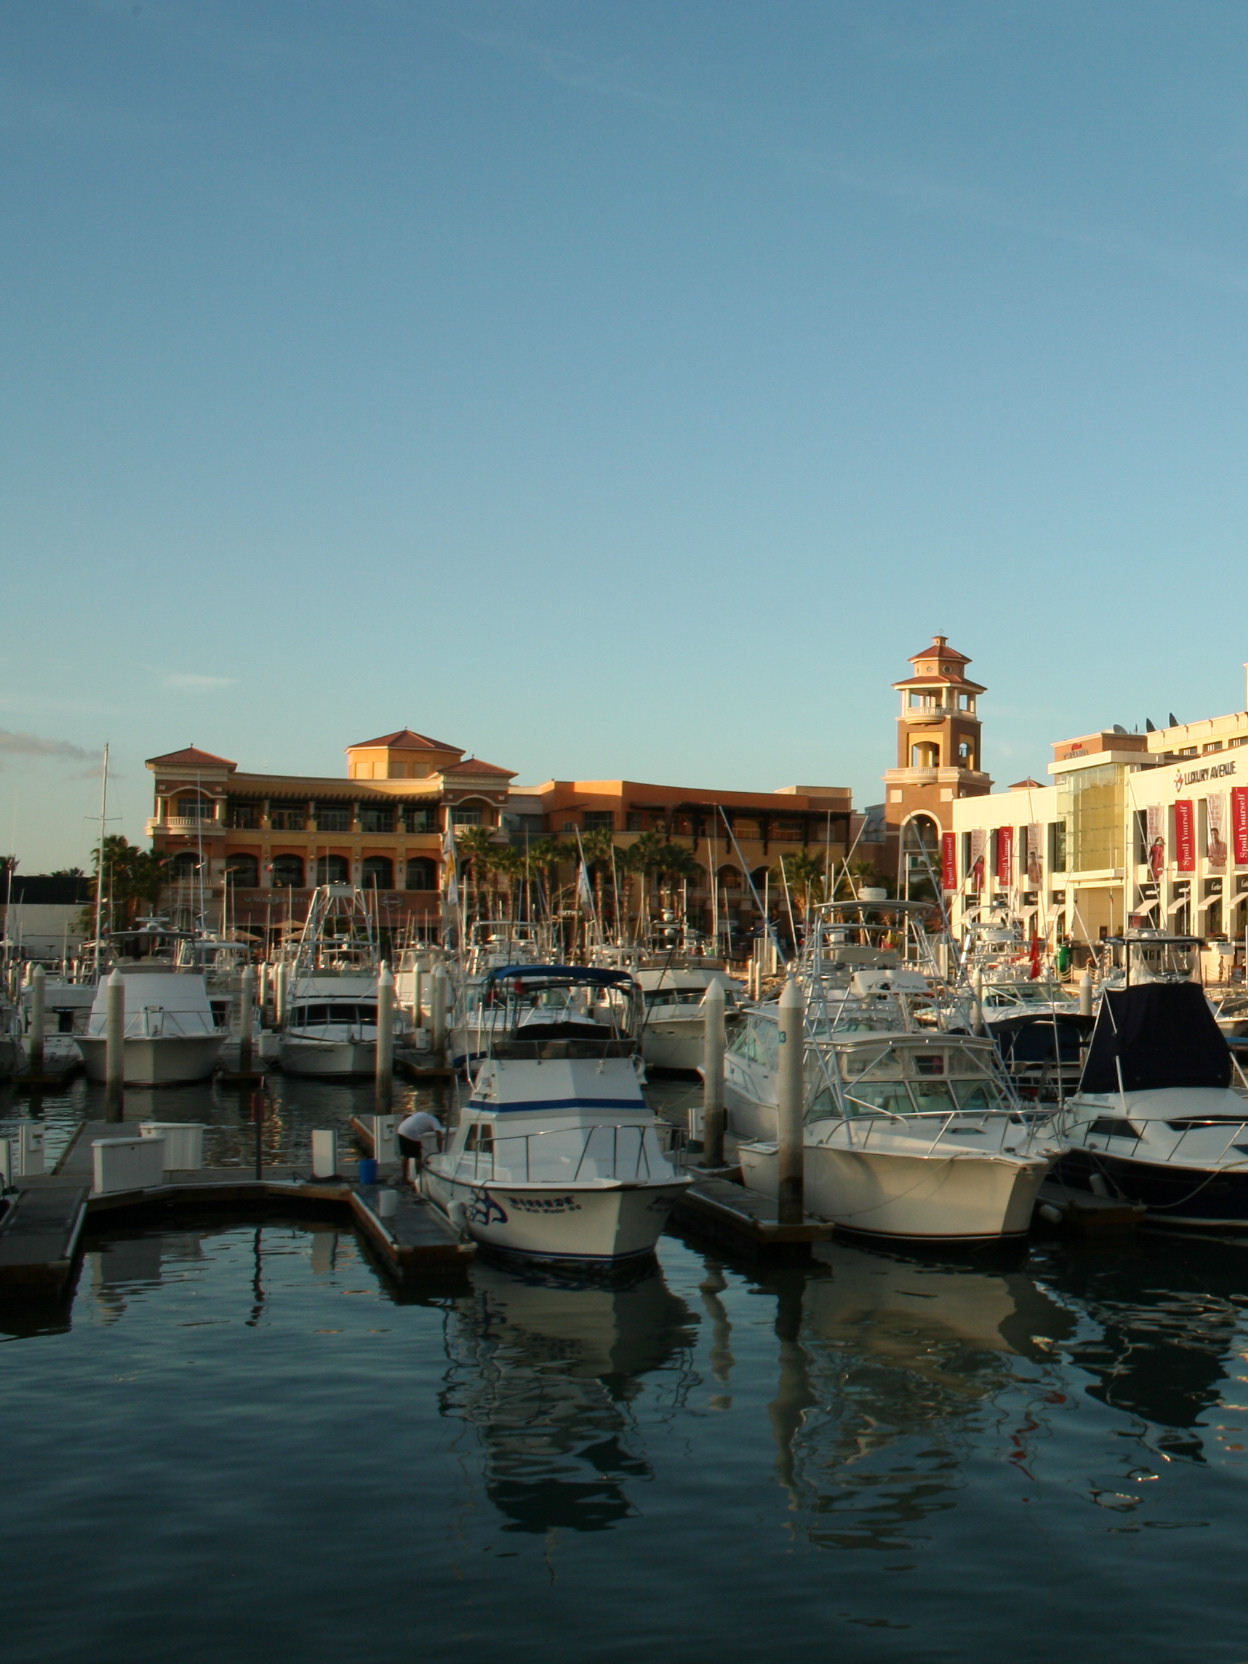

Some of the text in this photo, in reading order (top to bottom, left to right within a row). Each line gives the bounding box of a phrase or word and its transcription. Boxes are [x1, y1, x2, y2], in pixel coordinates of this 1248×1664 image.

[1184, 760, 1237, 785] LUXURY AVENUE
[1180, 805, 1191, 866] Spoil Yourself
[1237, 793, 1248, 858] Spoil Yourself
